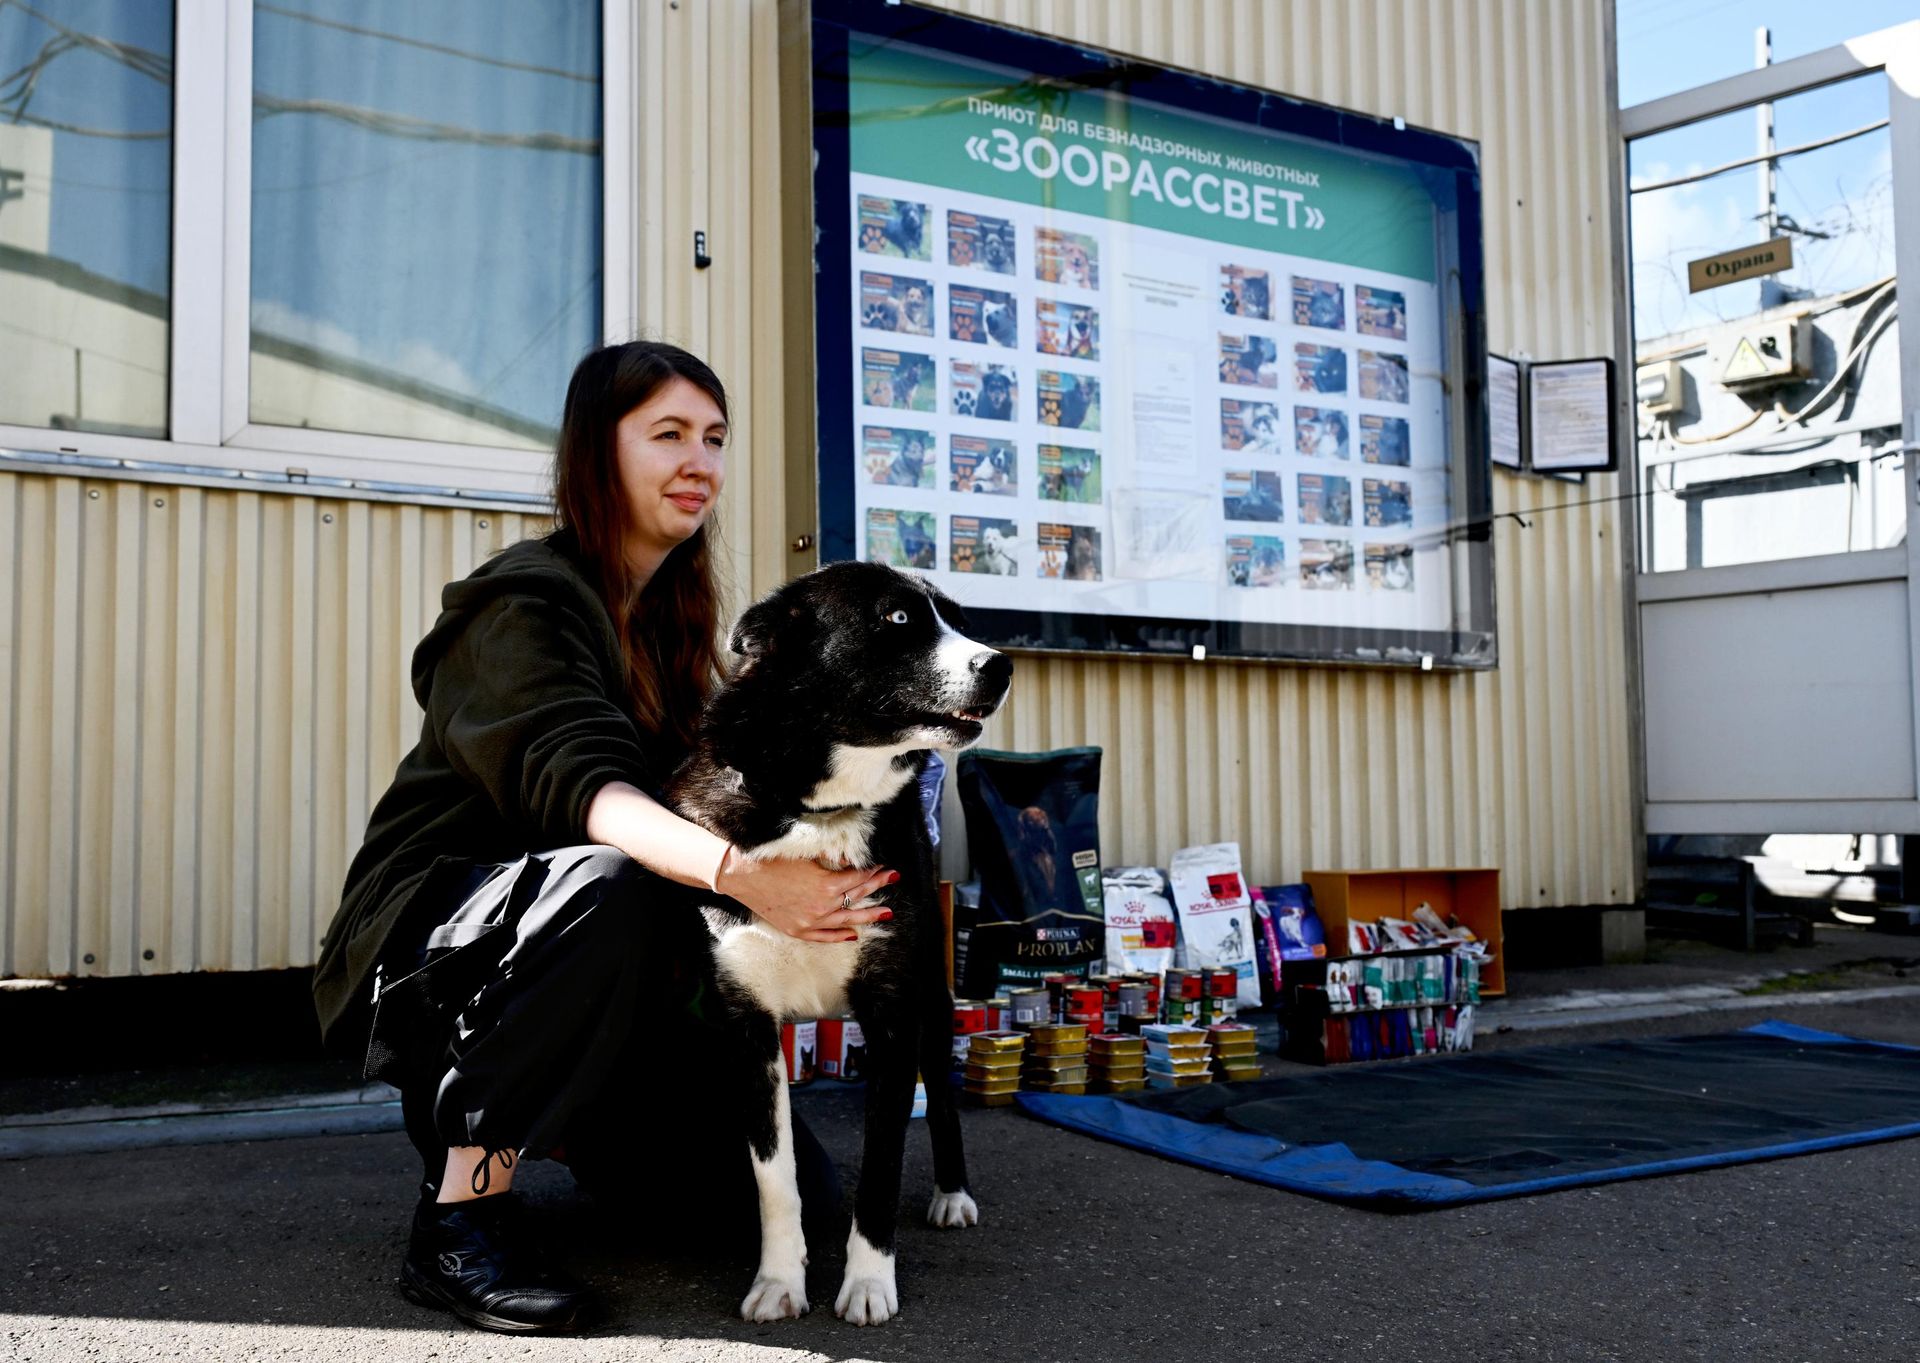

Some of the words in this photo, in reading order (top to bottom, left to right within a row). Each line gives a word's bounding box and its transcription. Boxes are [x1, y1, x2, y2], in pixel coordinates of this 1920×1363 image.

[967, 96, 1036, 127] ПРИЮТ
[1040, 113, 1079, 136] ДЛЯ
[1083, 122, 1222, 168] БЕЗНАДЗОРНЫХ
[1226, 155, 1320, 188] ЖИВОТНЫХ
[964, 128, 1325, 230] «ЗООРАССВЕТ»
[1705, 251, 1775, 277] Охрана
[1002, 968, 1031, 978] SMALL
